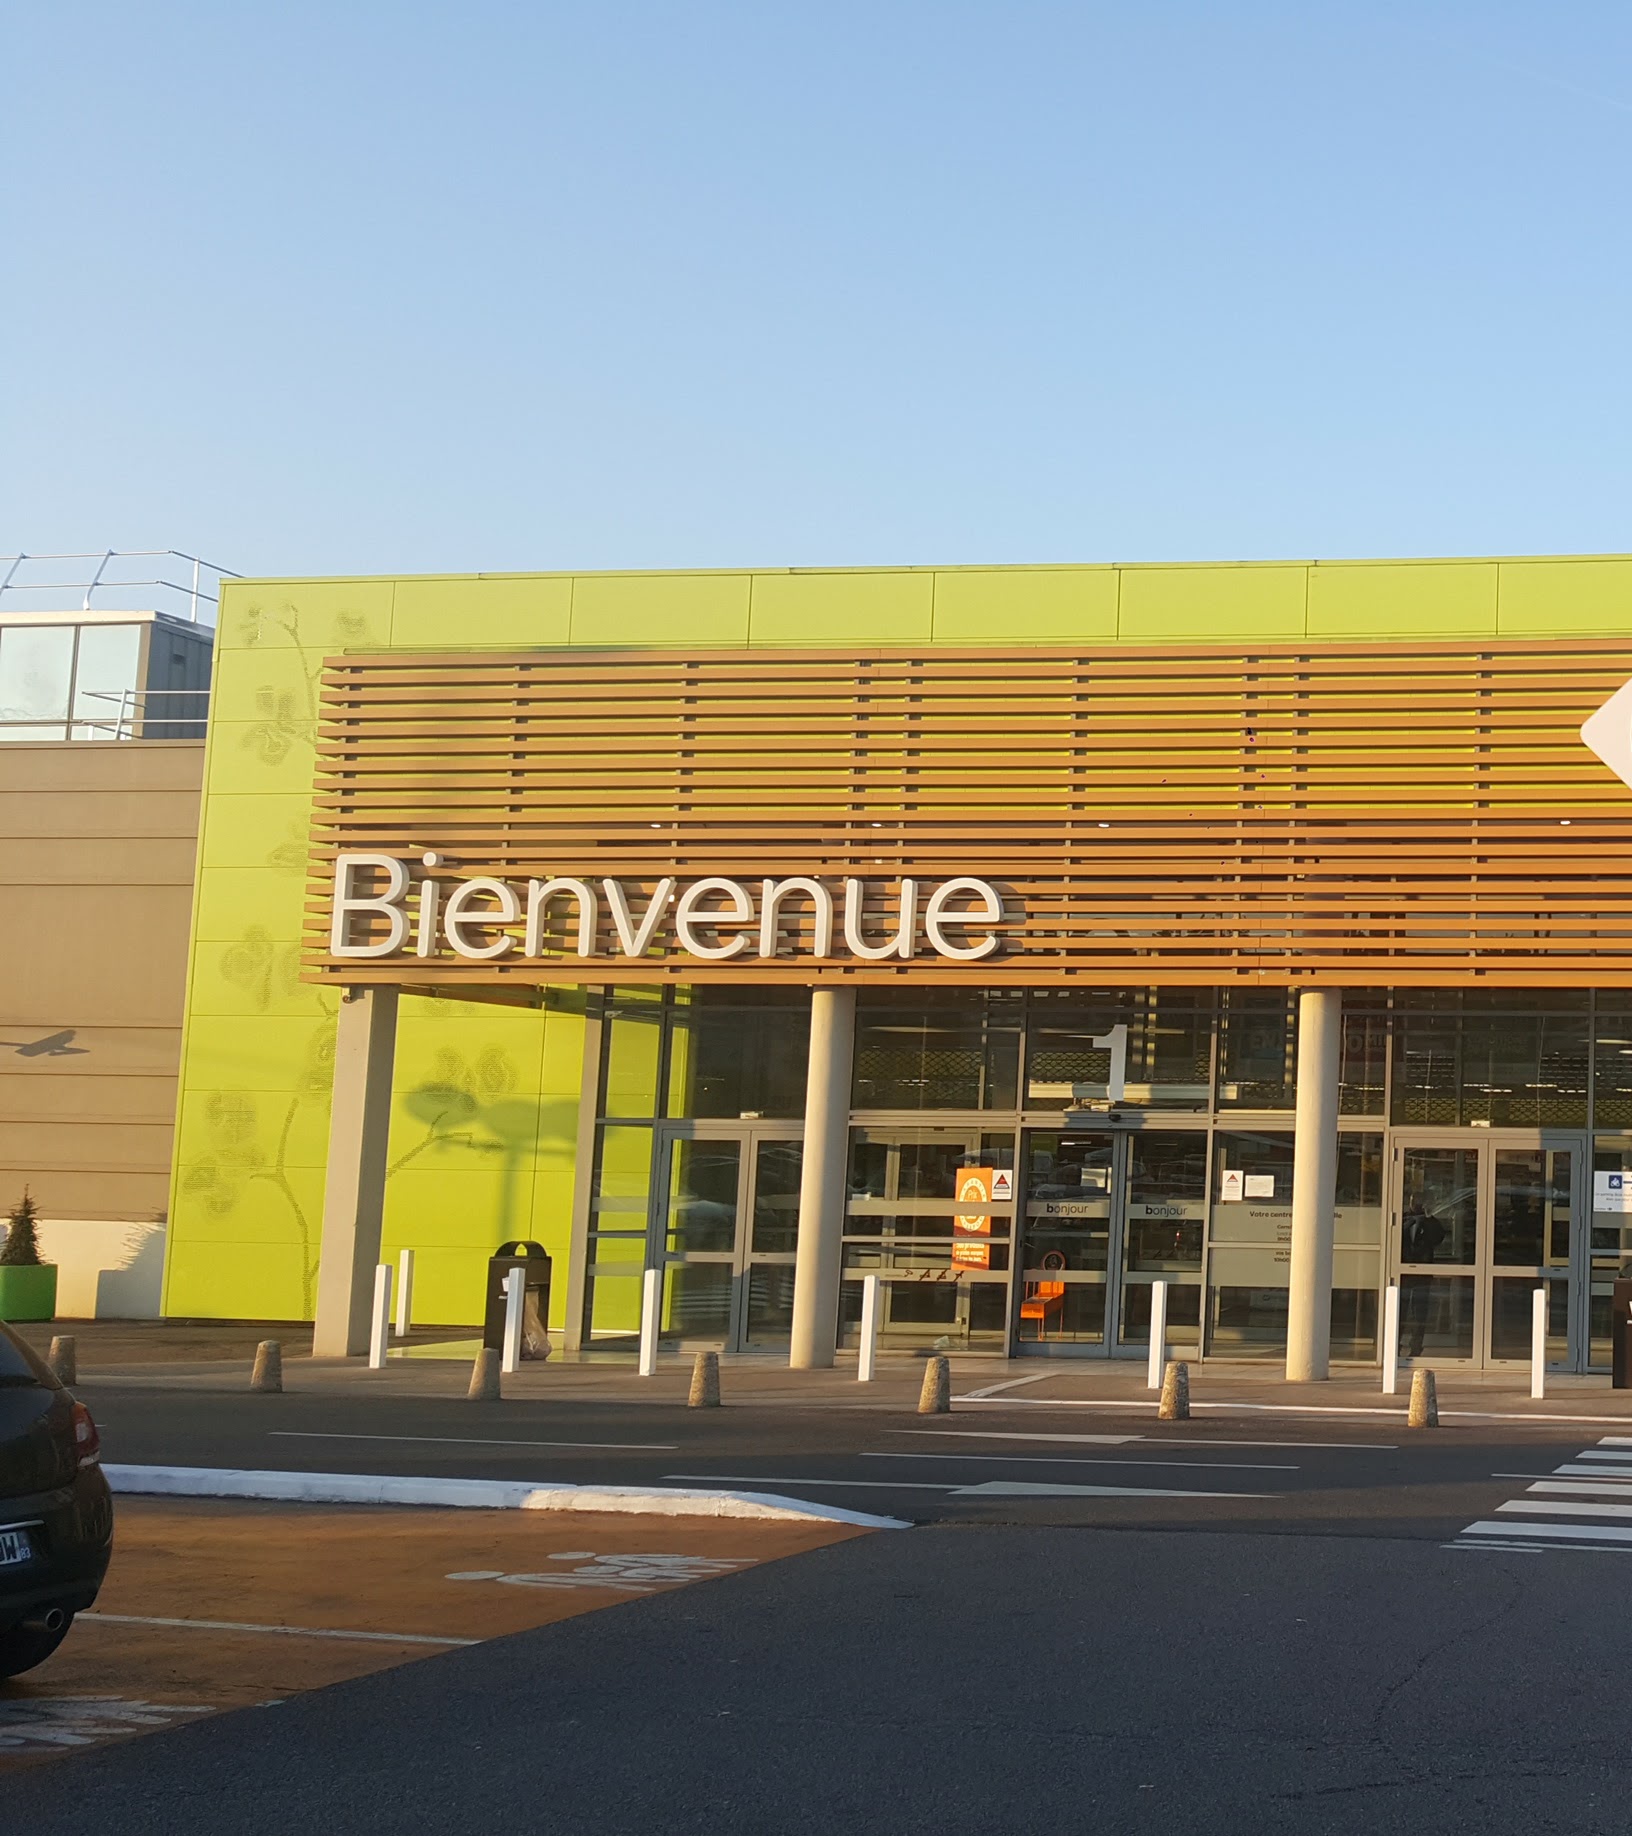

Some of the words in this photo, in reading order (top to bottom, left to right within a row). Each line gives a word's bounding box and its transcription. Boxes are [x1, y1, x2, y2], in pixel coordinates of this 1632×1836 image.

[330, 851, 1005, 961] Bienvenue
[1093, 1024, 1128, 1101] 1
[1046, 1203, 1089, 1215] bonjour
[1145, 1205, 1188, 1217] bonjour
